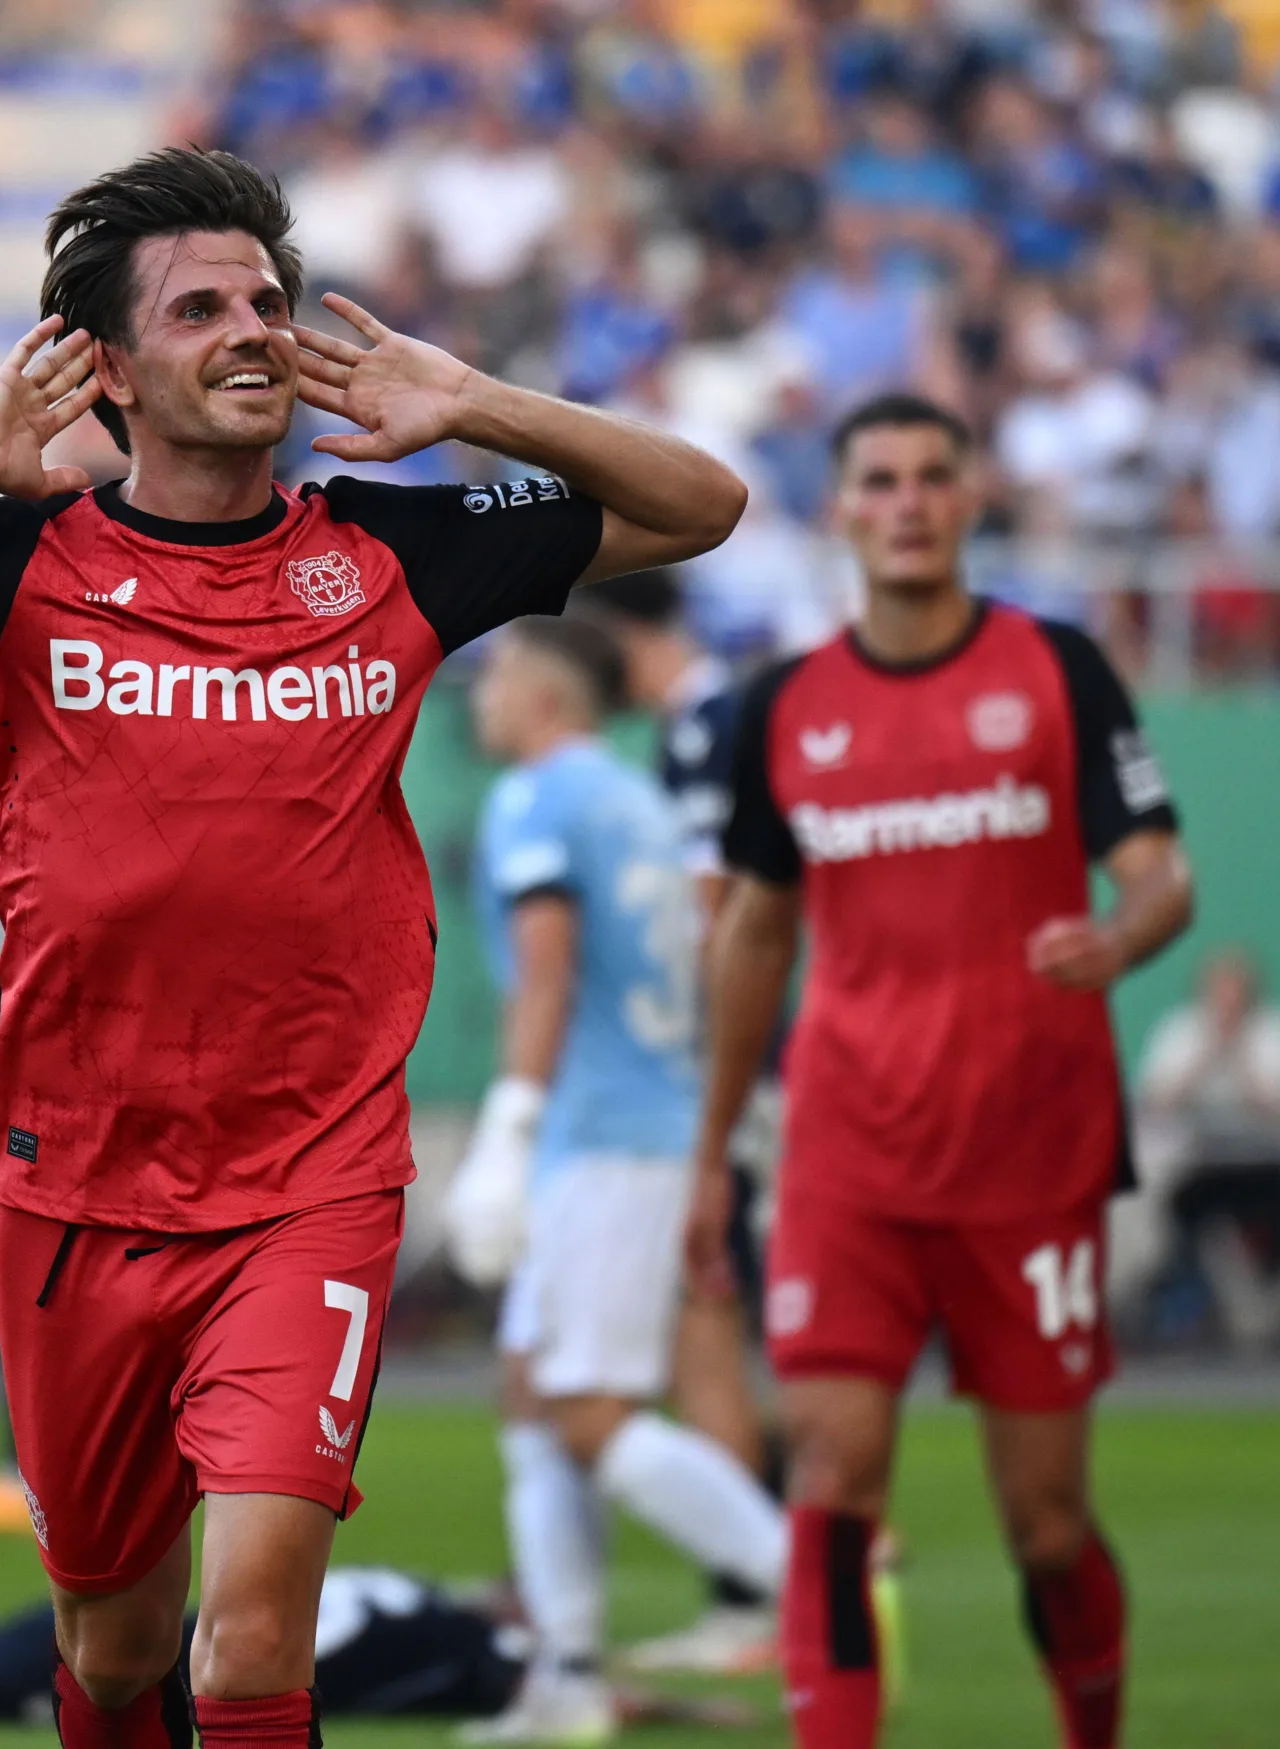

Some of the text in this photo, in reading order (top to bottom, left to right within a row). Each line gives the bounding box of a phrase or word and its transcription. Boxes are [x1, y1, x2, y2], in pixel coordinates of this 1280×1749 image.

[305, 560, 322, 571] 1904
[310, 579, 342, 594] BAYER
[85, 592, 115, 603] CAS
[313, 596, 361, 614] Leverkusen
[49, 638, 397, 722] Barmenia
[791, 773, 1051, 864] Barmenia
[1022, 1241, 1096, 1339] 14
[324, 1279, 370, 1402] 7
